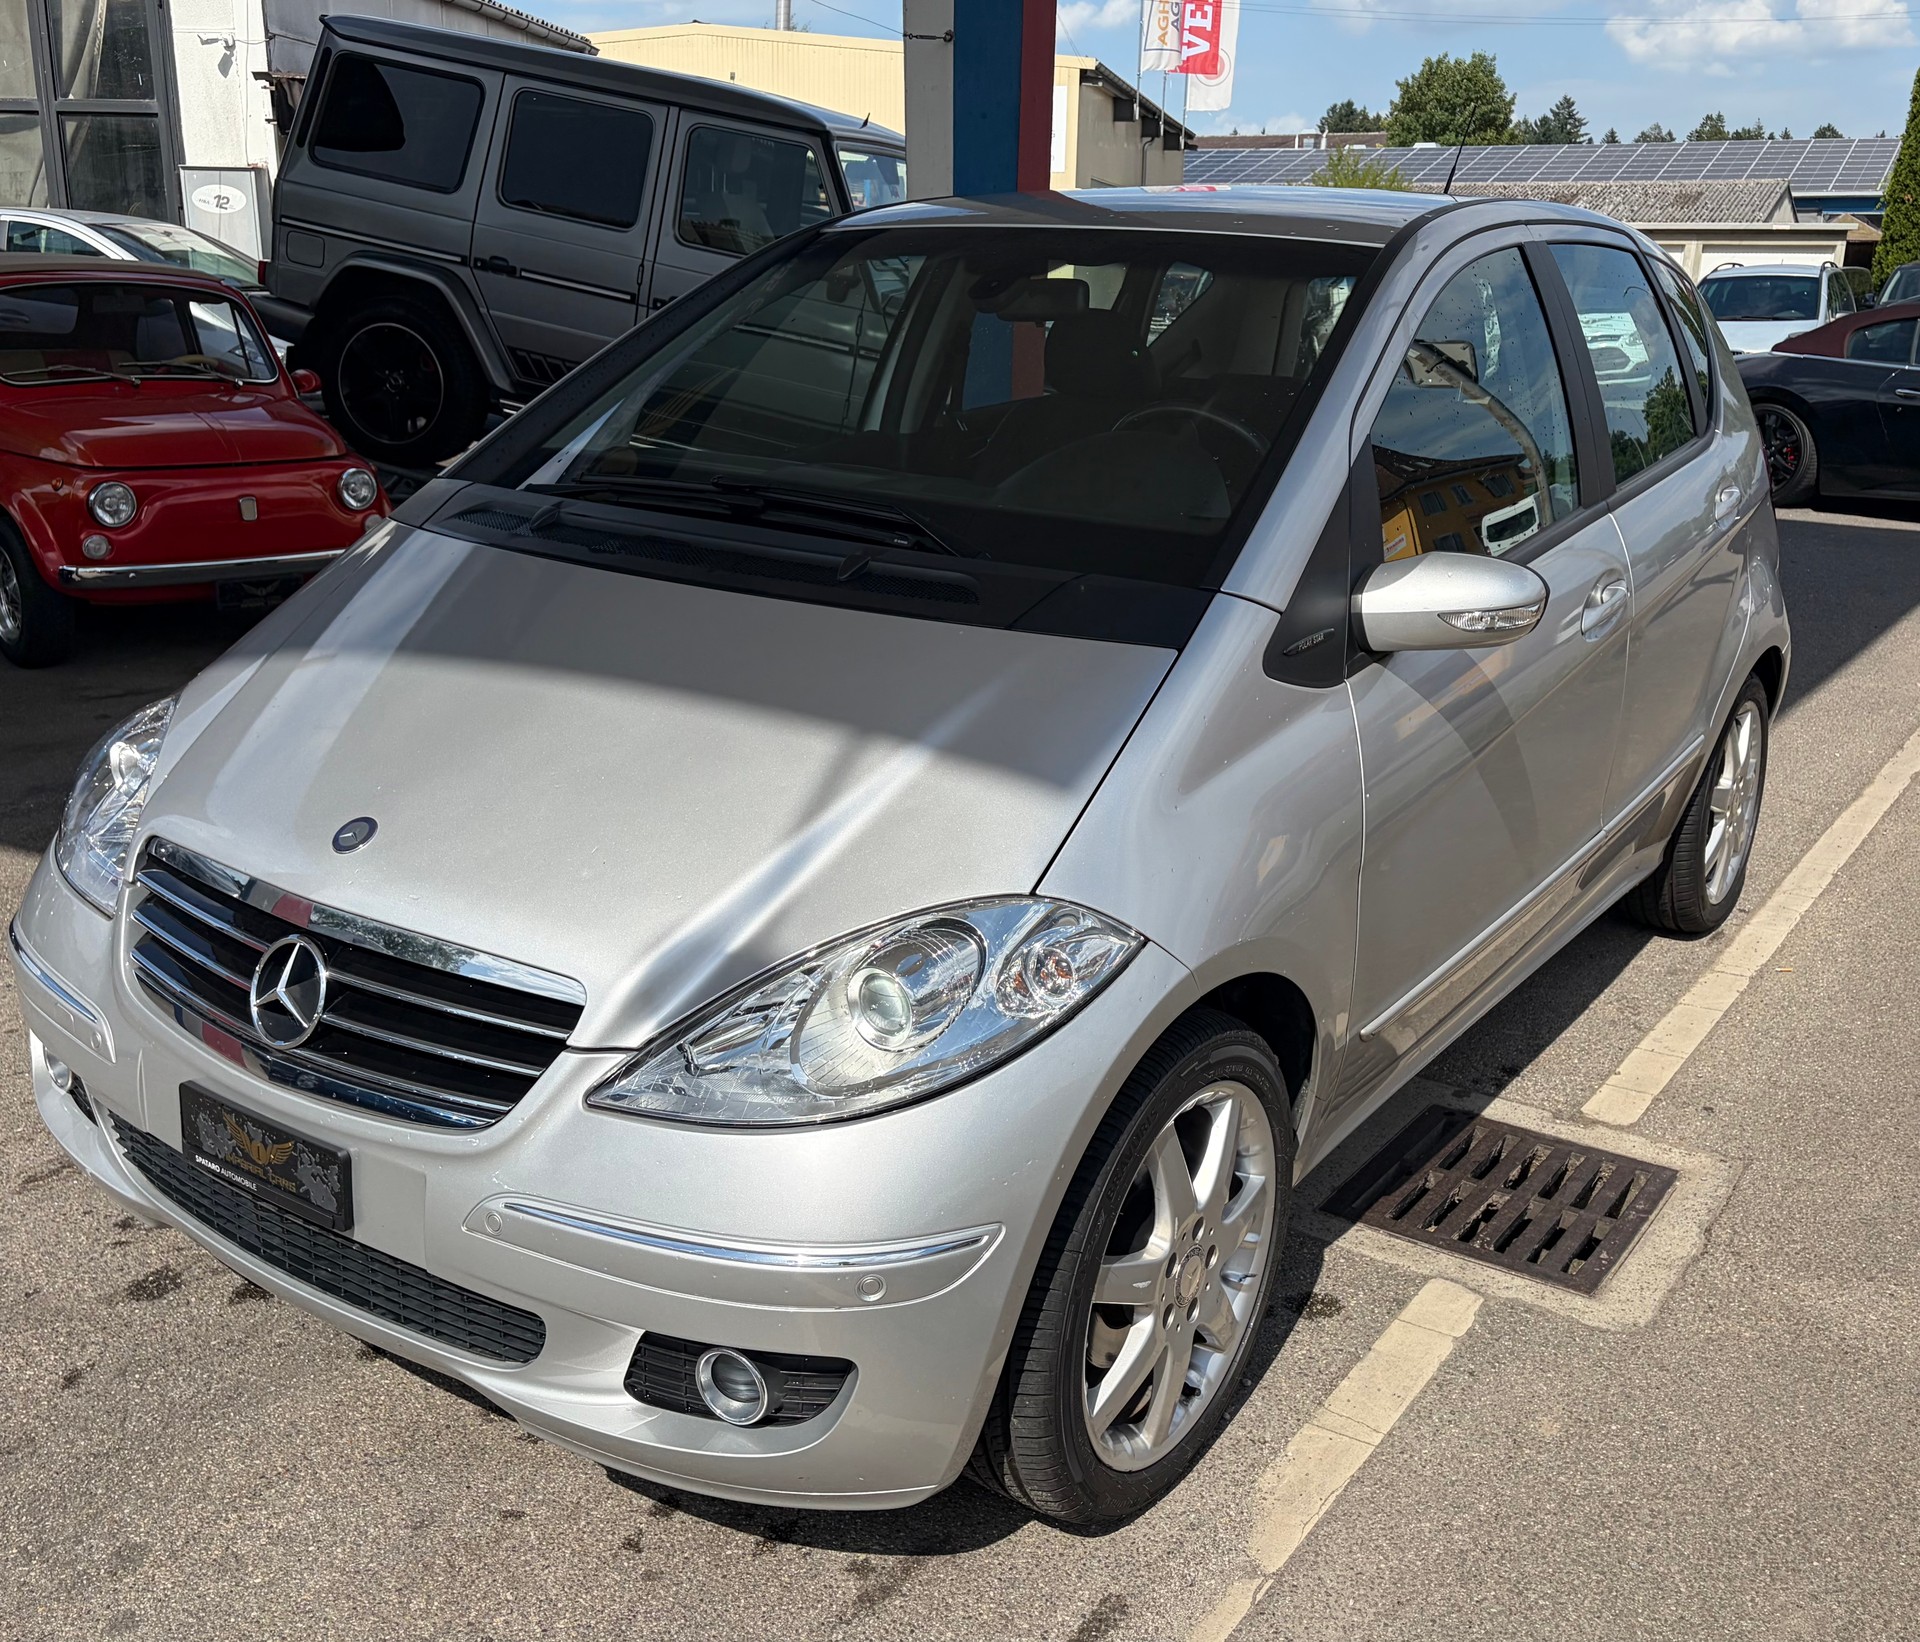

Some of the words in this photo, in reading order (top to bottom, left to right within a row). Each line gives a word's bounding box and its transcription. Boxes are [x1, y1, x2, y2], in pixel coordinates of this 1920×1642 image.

[1181, 0, 1214, 60] VE
[213, 194, 230, 210] 12
[1298, 637, 1312, 650] POLAR
[1312, 632, 1325, 645] STAR
[195, 1154, 221, 1173] SPATARO
[220, 1168, 258, 1191] AUTOMOBILE
